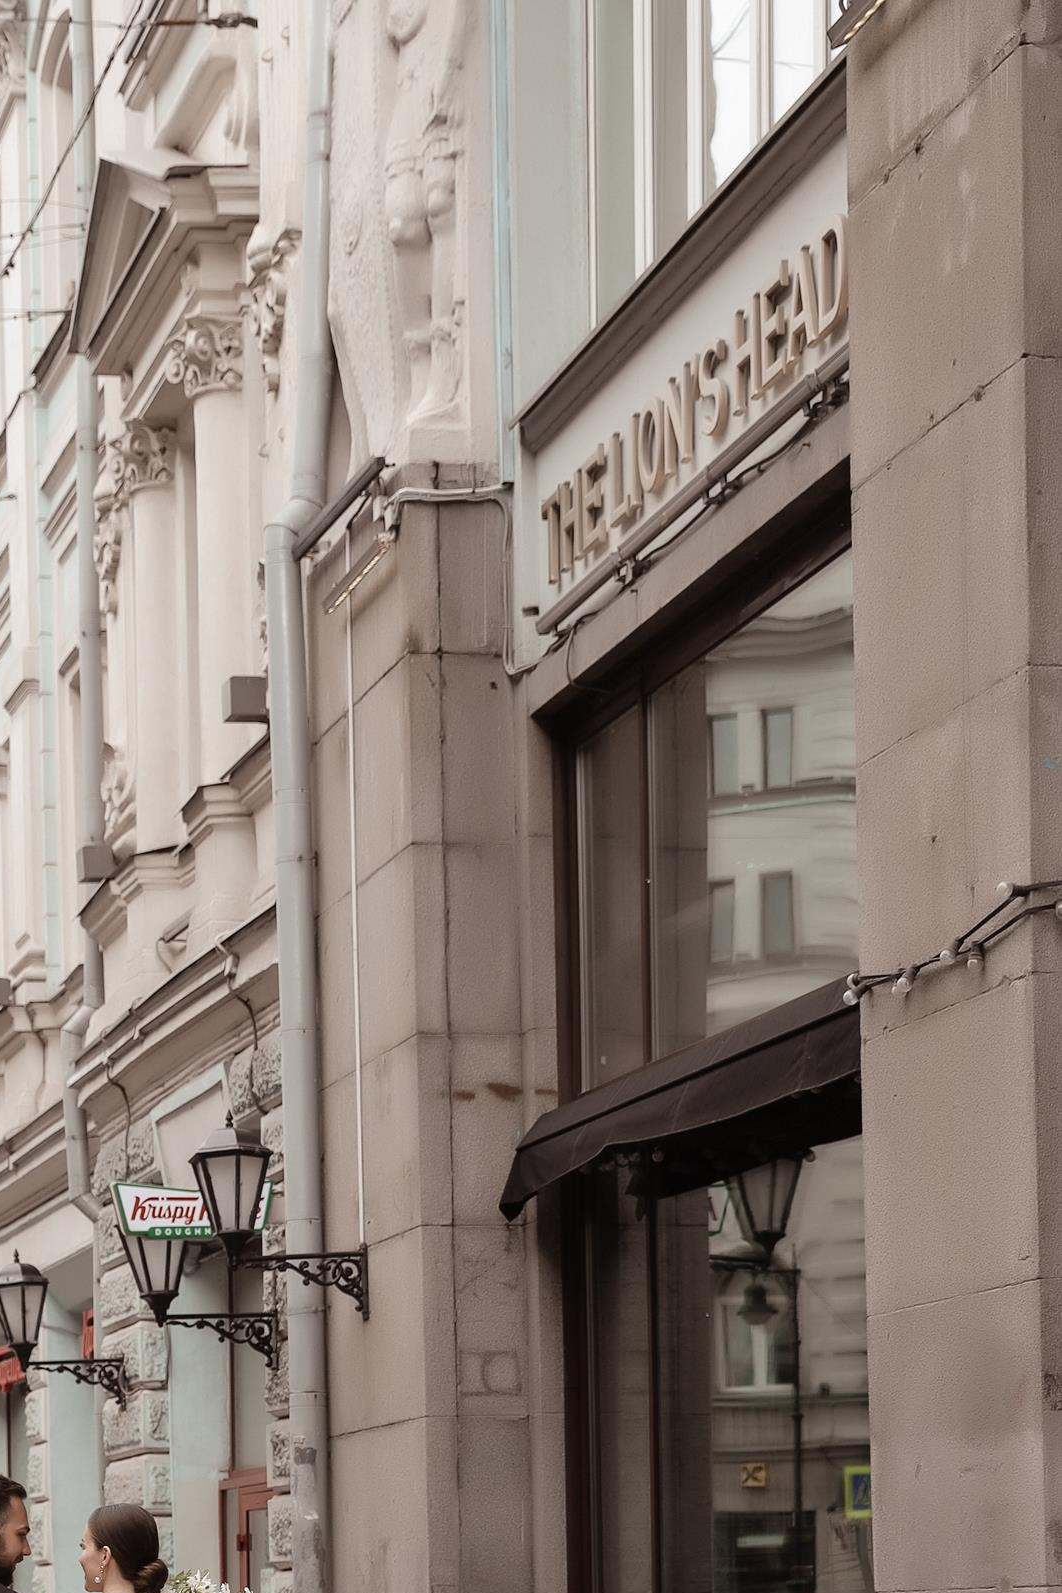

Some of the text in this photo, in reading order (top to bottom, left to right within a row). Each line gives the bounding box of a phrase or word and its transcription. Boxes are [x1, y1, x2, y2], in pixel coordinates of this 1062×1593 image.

[541, 213, 849, 585] THE LION'S HEAD
[130, 1195, 200, 1225] Krispy
[154, 1227, 212, 1237] DOUGHN
